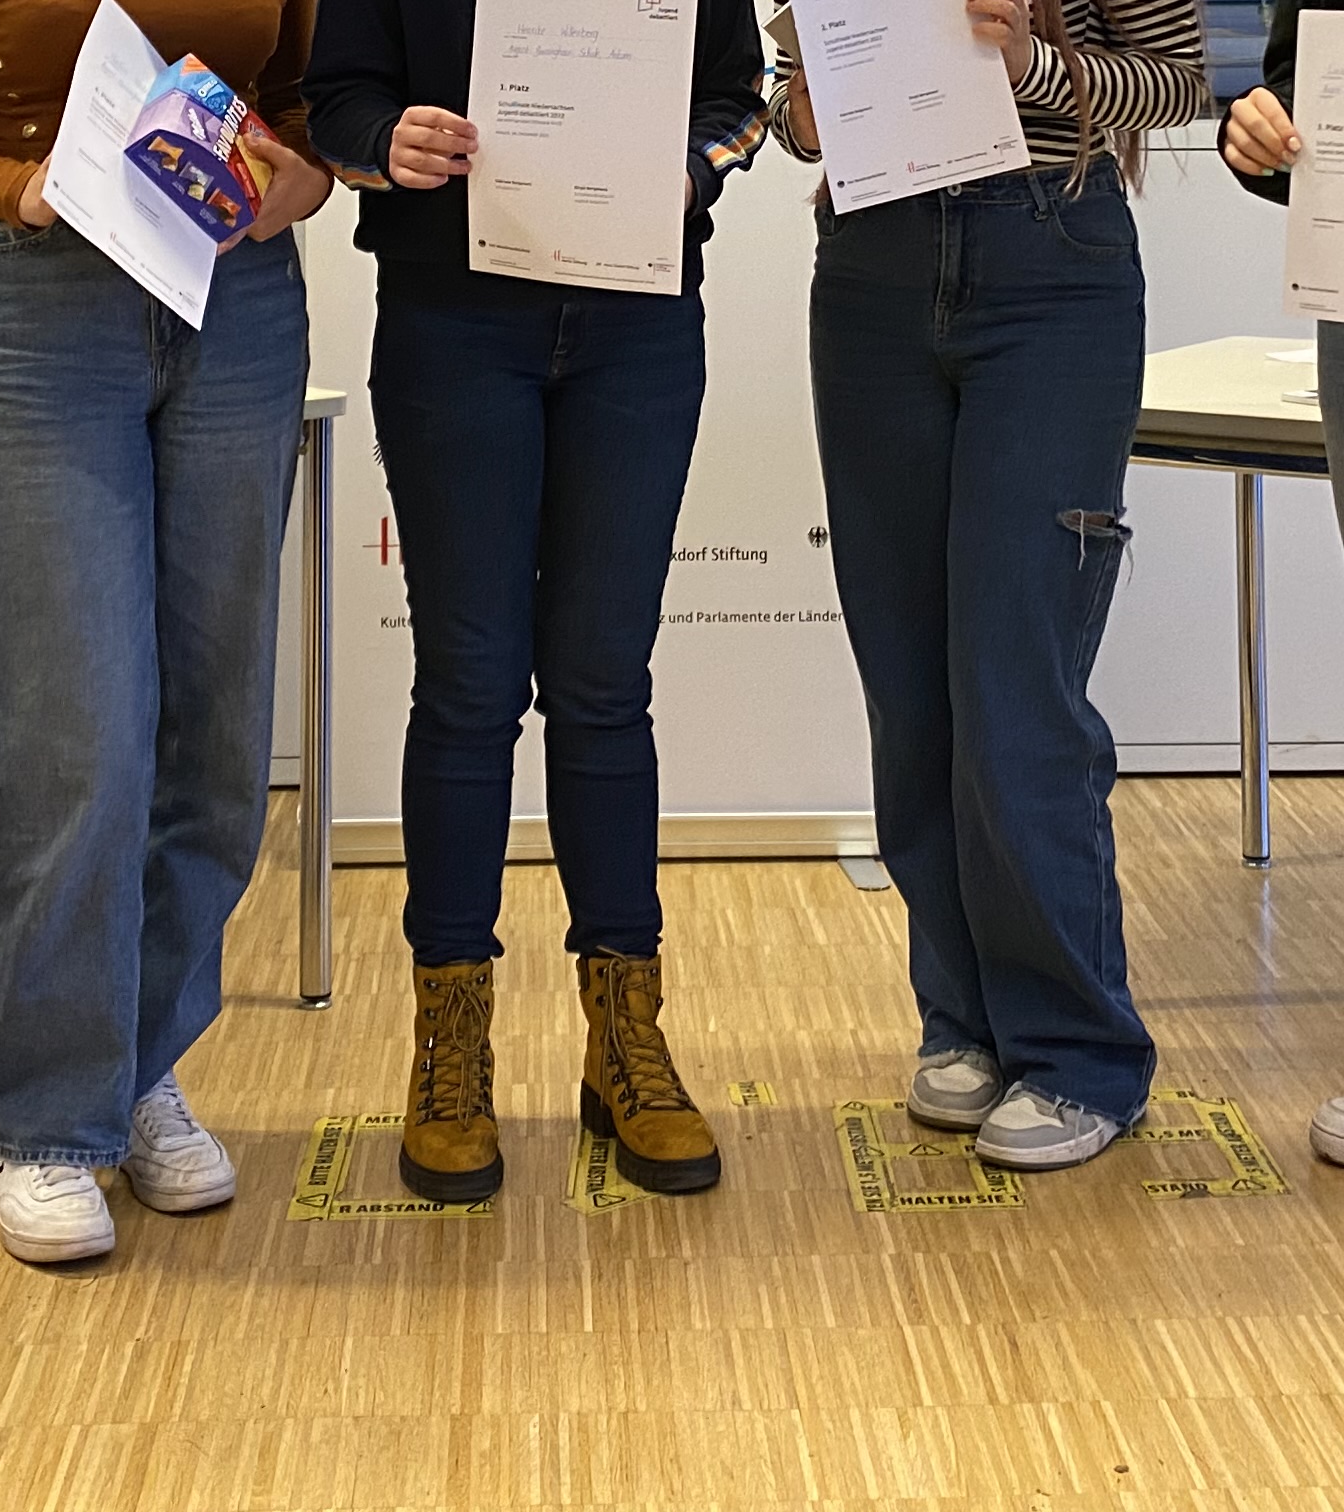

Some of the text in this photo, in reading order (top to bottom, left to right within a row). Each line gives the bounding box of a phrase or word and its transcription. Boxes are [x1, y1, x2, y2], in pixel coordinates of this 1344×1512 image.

[509, 84, 530, 92] Platz
[671, 547, 768, 564] xdorf Stiftung
[668, 612, 693, 623] und
[696, 610, 771, 623] Parlamente
[773, 610, 796, 622] der
[900, 1194, 972, 1205] HALTEN
[977, 1194, 1006, 1204] SIE
[357, 1202, 446, 1214] ABSTAND
